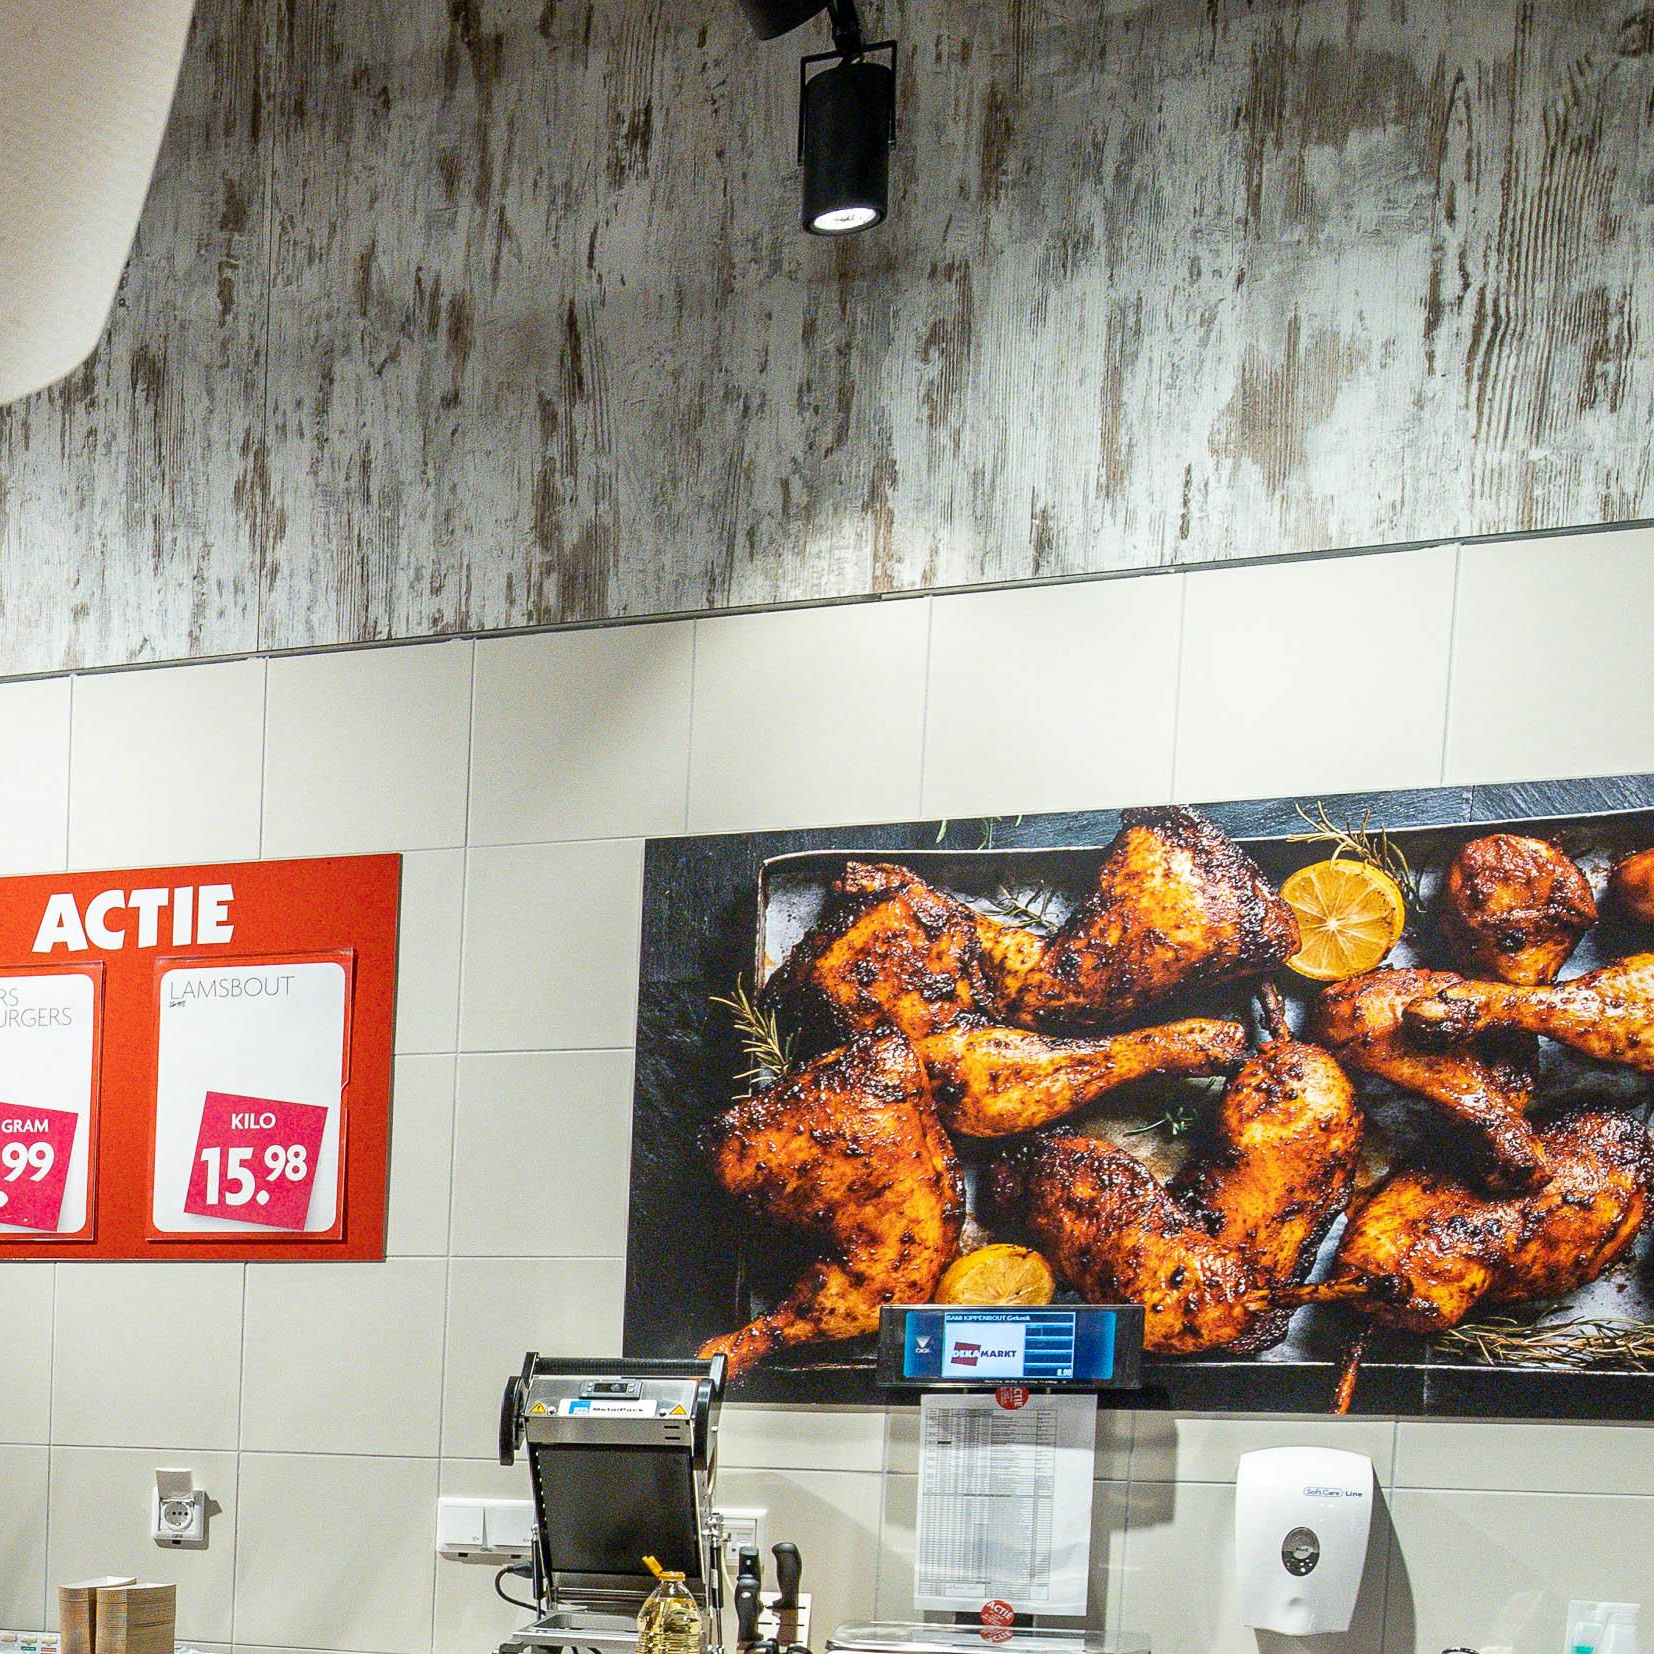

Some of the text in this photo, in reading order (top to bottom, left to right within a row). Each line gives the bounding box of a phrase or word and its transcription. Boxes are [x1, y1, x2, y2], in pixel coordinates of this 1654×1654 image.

[31, 884, 235, 953] ACTIE
[169, 975, 295, 1000] LAMSBOUT
[0, 1118, 50, 1134] GRAM
[231, 1112, 276, 1130] KILO
[200, 1143, 308, 1207] 15.98
